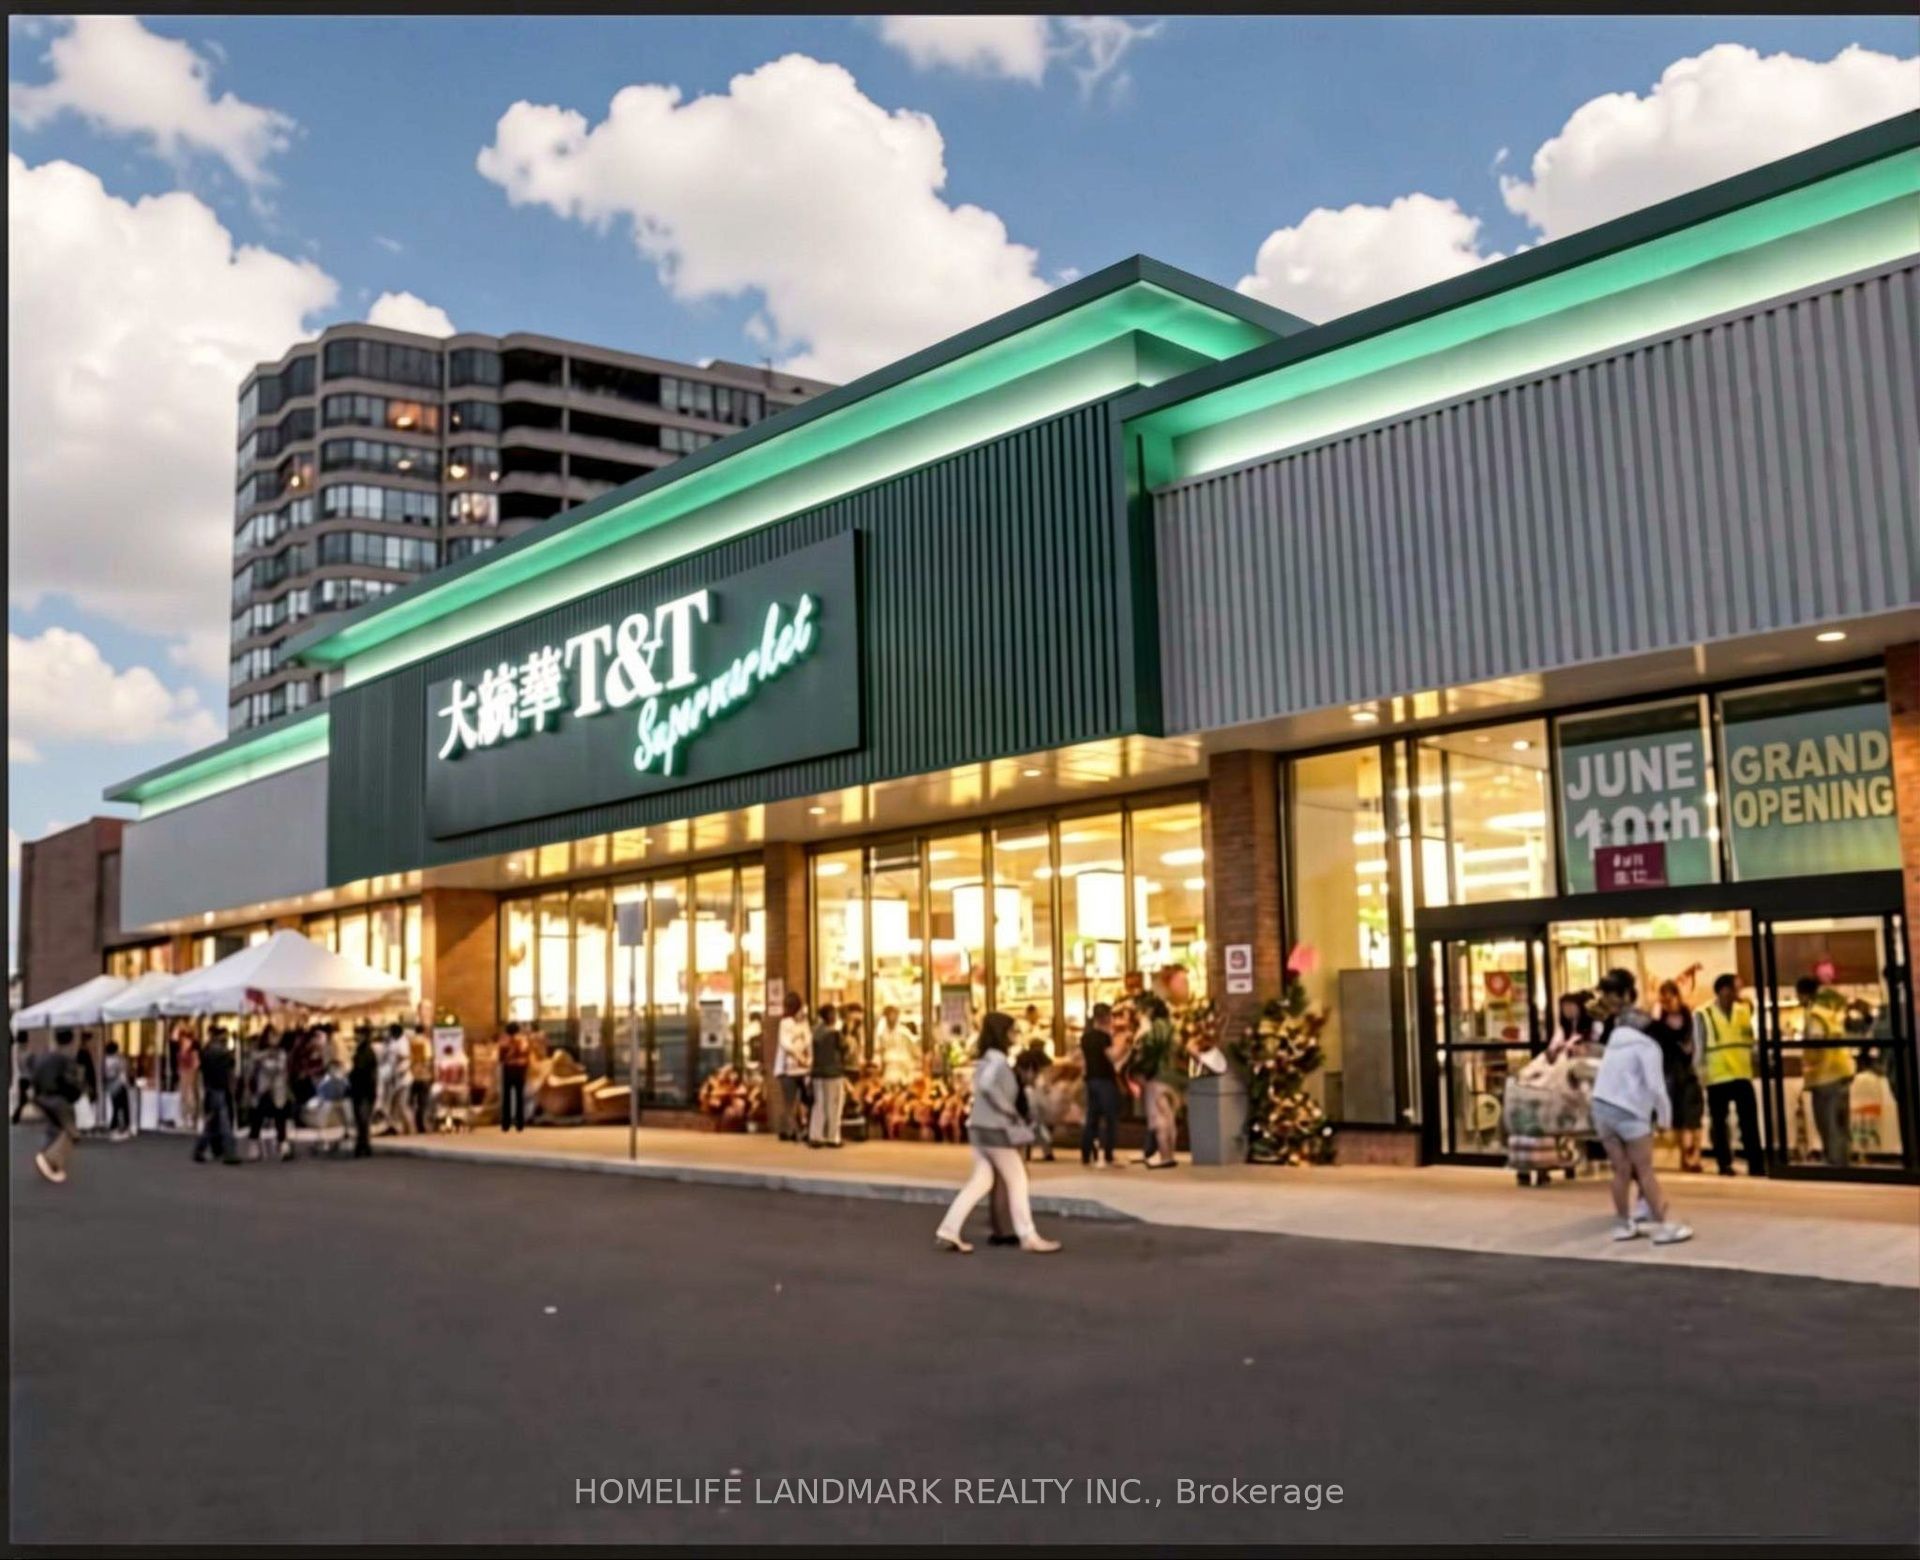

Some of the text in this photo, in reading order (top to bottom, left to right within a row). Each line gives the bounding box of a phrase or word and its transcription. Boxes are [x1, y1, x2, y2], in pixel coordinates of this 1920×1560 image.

[564, 588, 709, 718] T&T
[633, 593, 814, 777] Supermarket
[1567, 742, 1696, 801] JUNE
[1730, 730, 1890, 786] GRAND
[1574, 797, 1701, 862] 10th
[1733, 775, 1895, 829] OPENING
